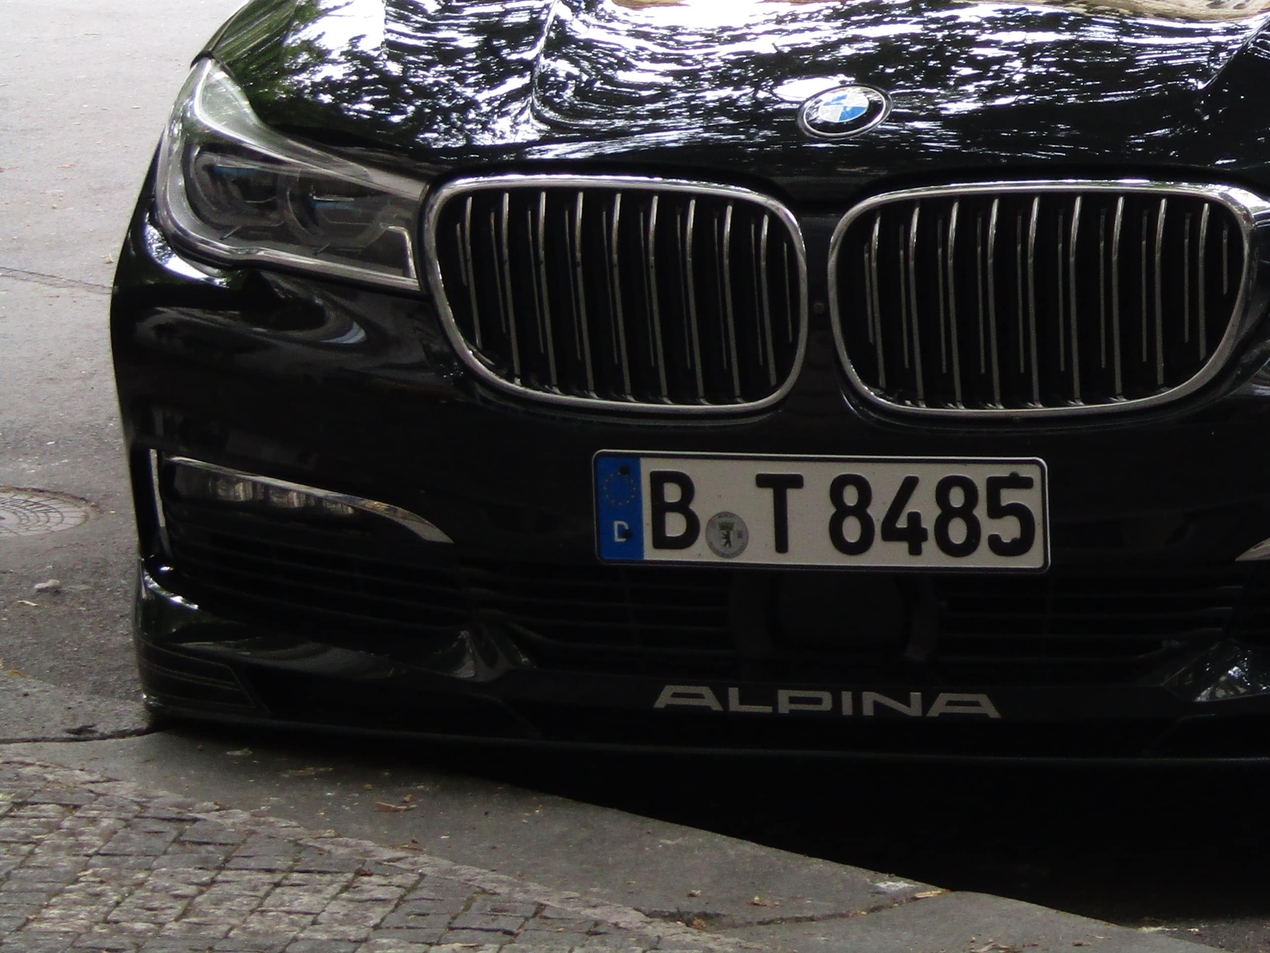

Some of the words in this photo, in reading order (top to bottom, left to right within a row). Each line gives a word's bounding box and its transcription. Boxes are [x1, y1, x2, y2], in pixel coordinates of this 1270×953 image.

[650, 470, 700, 549] B
[755, 473, 804, 553] T
[828, 472, 1036, 557] 8485
[653, 684, 1000, 719] ALPINA
